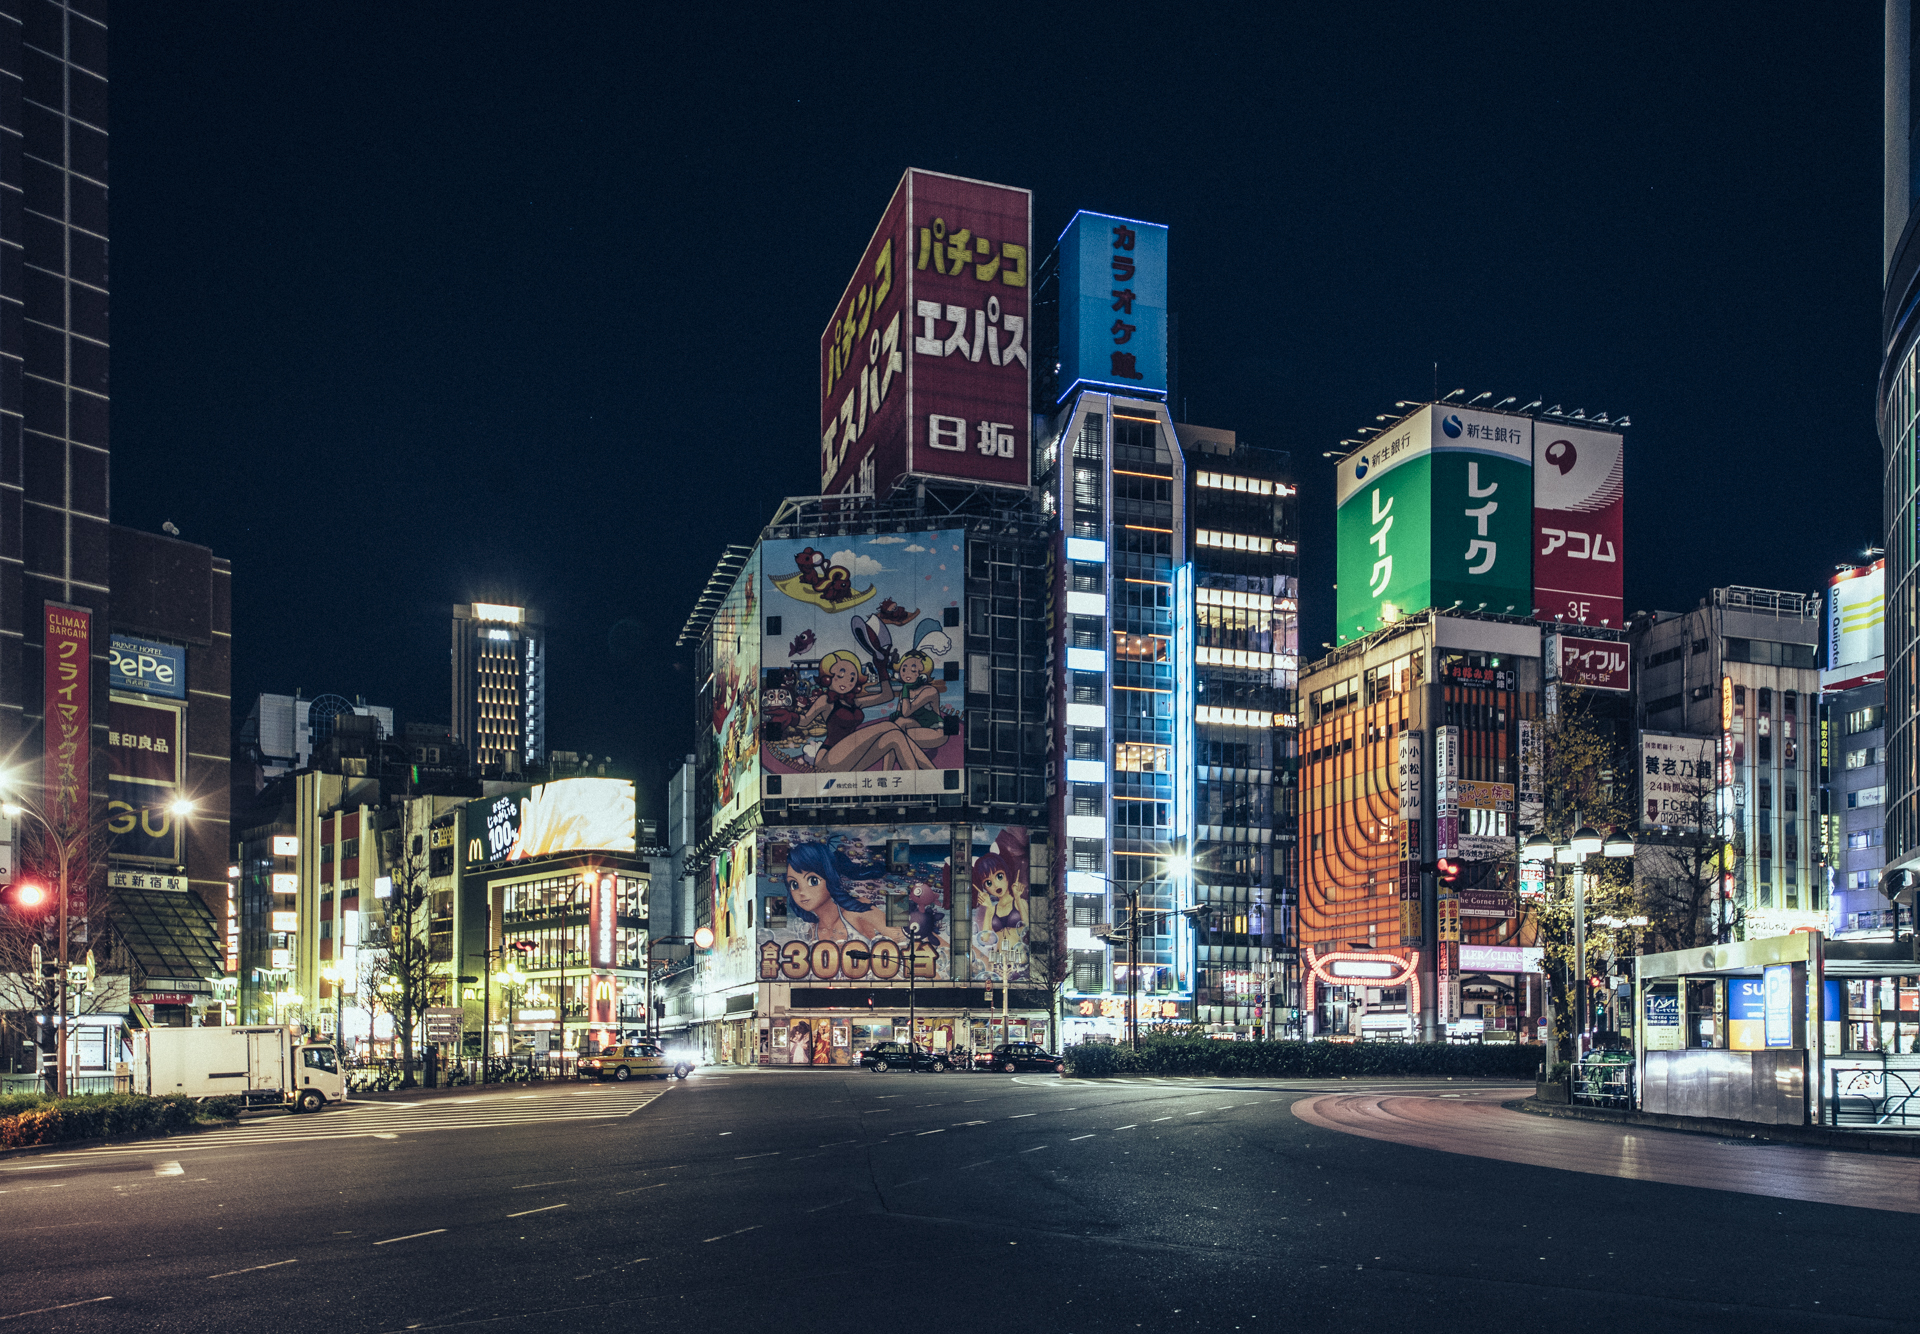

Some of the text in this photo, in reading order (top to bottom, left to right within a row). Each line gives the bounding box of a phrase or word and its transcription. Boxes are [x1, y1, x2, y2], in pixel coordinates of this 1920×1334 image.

[916, 217, 1027, 288] パチンコ
[827, 237, 892, 399] パチンコ
[915, 295, 1028, 370] エスパス
[822, 310, 902, 494] エスパス
[928, 413, 1015, 459] 日拓
[1466, 422, 1522, 445] 新生銀行
[1371, 430, 1411, 468] 新生銀行
[1464, 461, 1499, 575] レイク
[1369, 487, 1394, 598] レイク
[1541, 526, 1616, 563] アコム
[49, 613, 87, 630] CLIMAX
[1567, 601, 1591, 619] 3F
[49, 624, 87, 640] BARGAIN
[1832, 588, 1841, 665] Don Quijote
[139, 643, 163, 657] HOTEL
[1563, 646, 1626, 672] アイフル
[109, 731, 169, 754] 無印良品
[862, 776, 903, 789] 北電子
[1410, 745, 1420, 808] 小松ビル
[1491, 785, 1511, 800] 焼き
[108, 800, 171, 839] GU
[487, 803, 518, 829] じゃがいも
[488, 820, 520, 854] 100%
[113, 872, 181, 891] 武新宿駅
[1471, 897, 1495, 906] Corner
[1497, 898, 1508, 906] 117
[178, 981, 198, 989] PePe
[1739, 1026, 1754, 1046] 4
